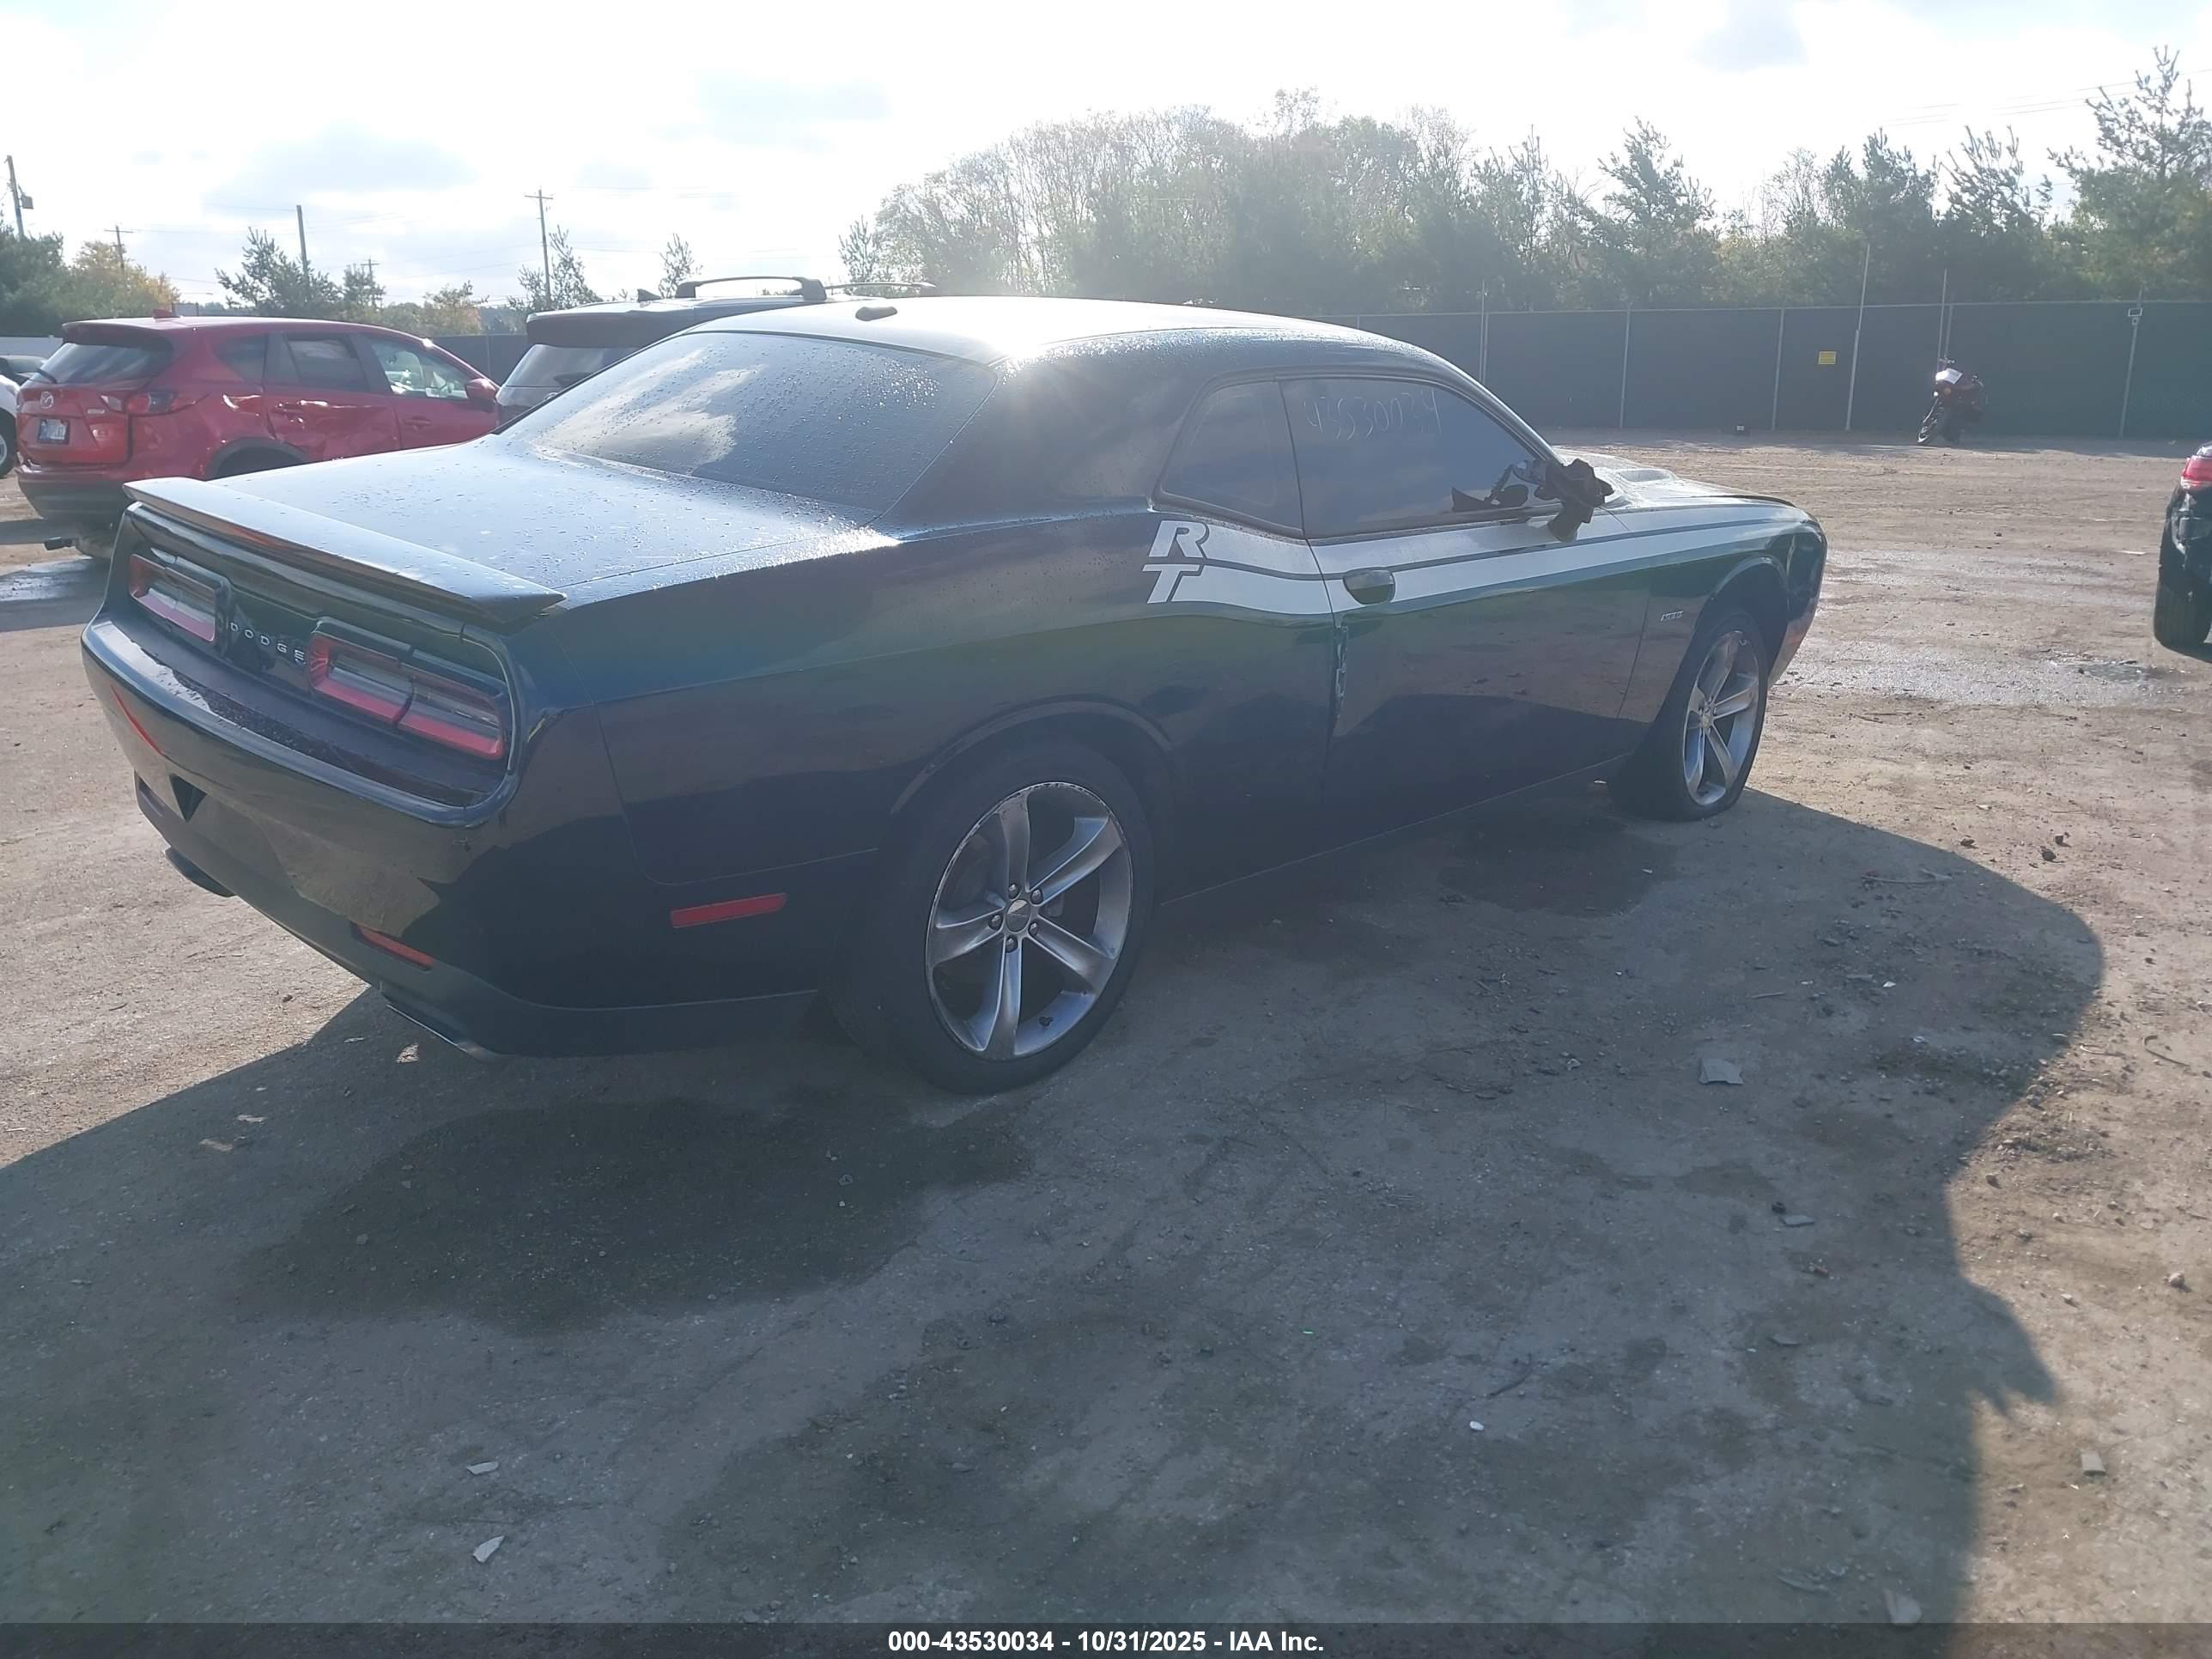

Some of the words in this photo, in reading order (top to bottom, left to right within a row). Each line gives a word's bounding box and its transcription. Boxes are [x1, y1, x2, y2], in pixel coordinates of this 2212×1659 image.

[1148, 520, 1207, 559] R
[1141, 563, 1200, 605] T
[230, 622, 306, 662] DODGE
